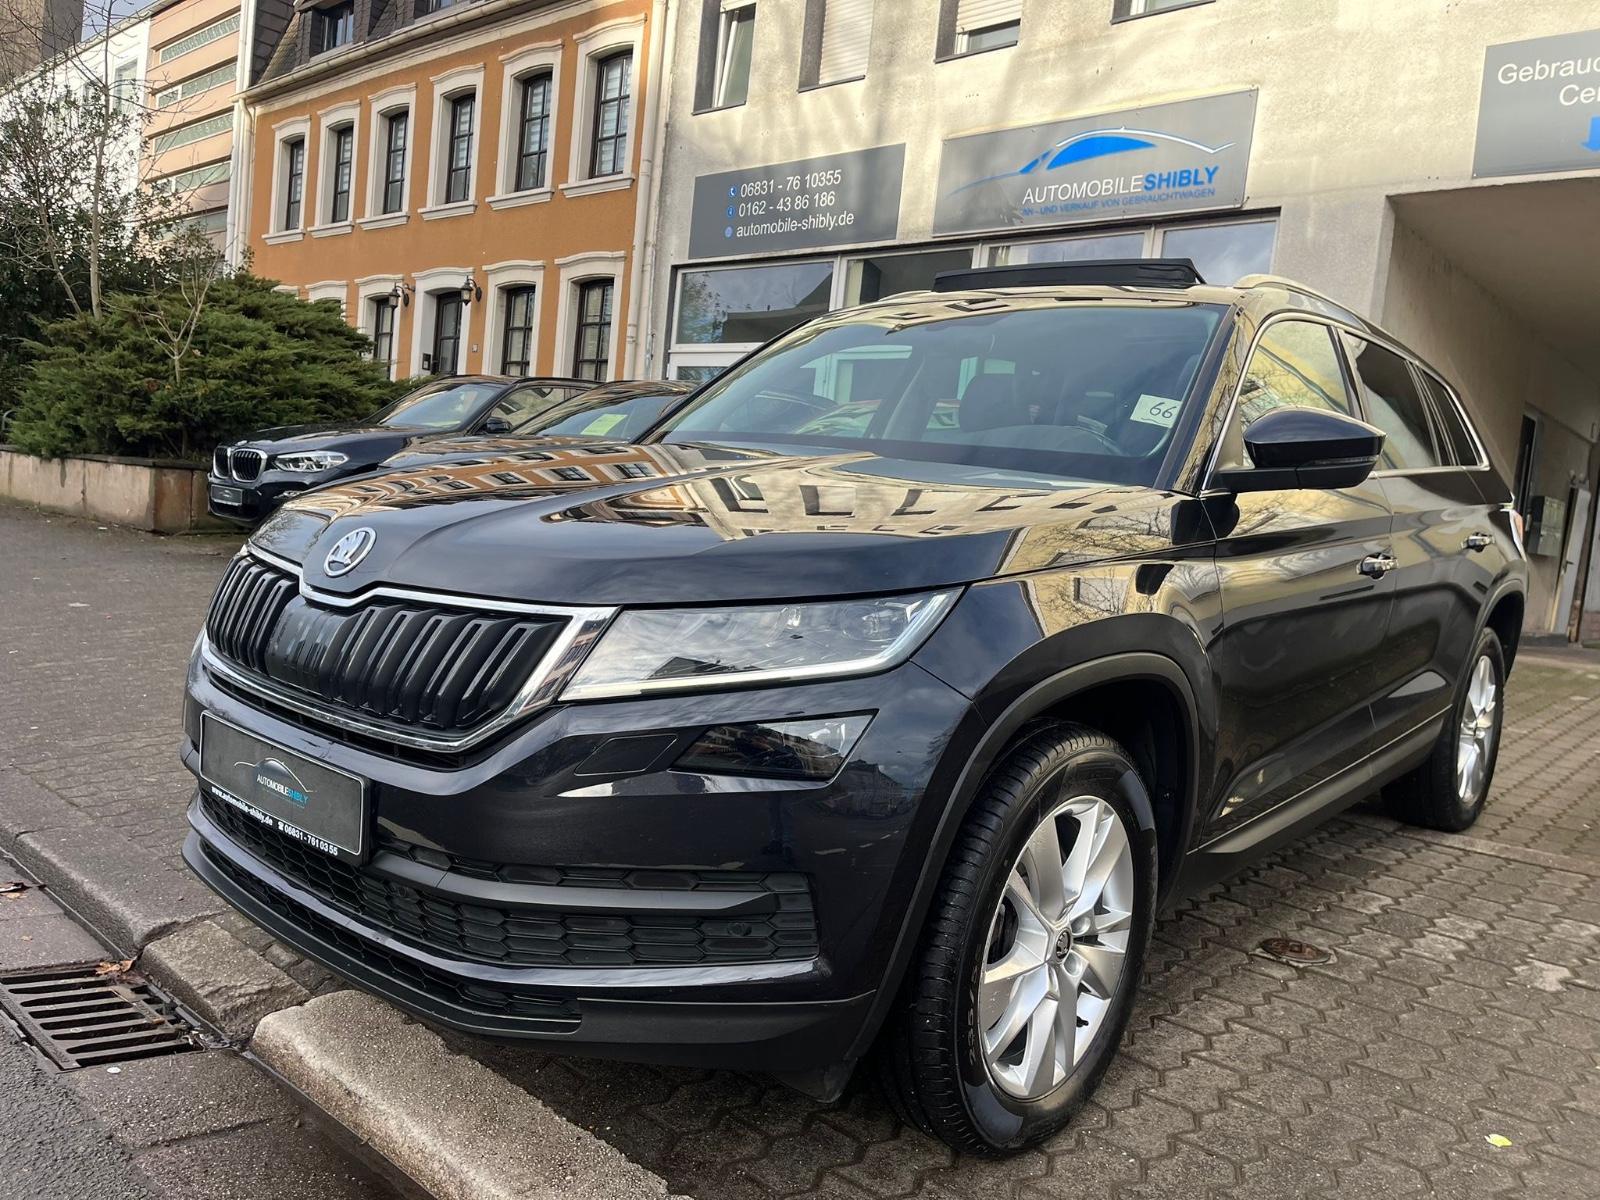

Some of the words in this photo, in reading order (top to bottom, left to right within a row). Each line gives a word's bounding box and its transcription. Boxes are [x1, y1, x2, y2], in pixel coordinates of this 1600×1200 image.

[1559, 84, 1600, 106] Ce
[740, 179, 774, 198] 06831
[786, 175, 800, 192] 76
[805, 168, 842, 189] 10355
[738, 201, 766, 218] 0162
[776, 197, 789, 212] 43
[794, 194, 809, 210] 86
[813, 191, 835, 208] 186
[1040, 205, 1057, 215] UND
[1060, 201, 1099, 212] VERKAUF
[1101, 198, 1120, 208] VON
[736, 210, 855, 238] automobile-shibly.de
[1150, 402, 1177, 418] 66
